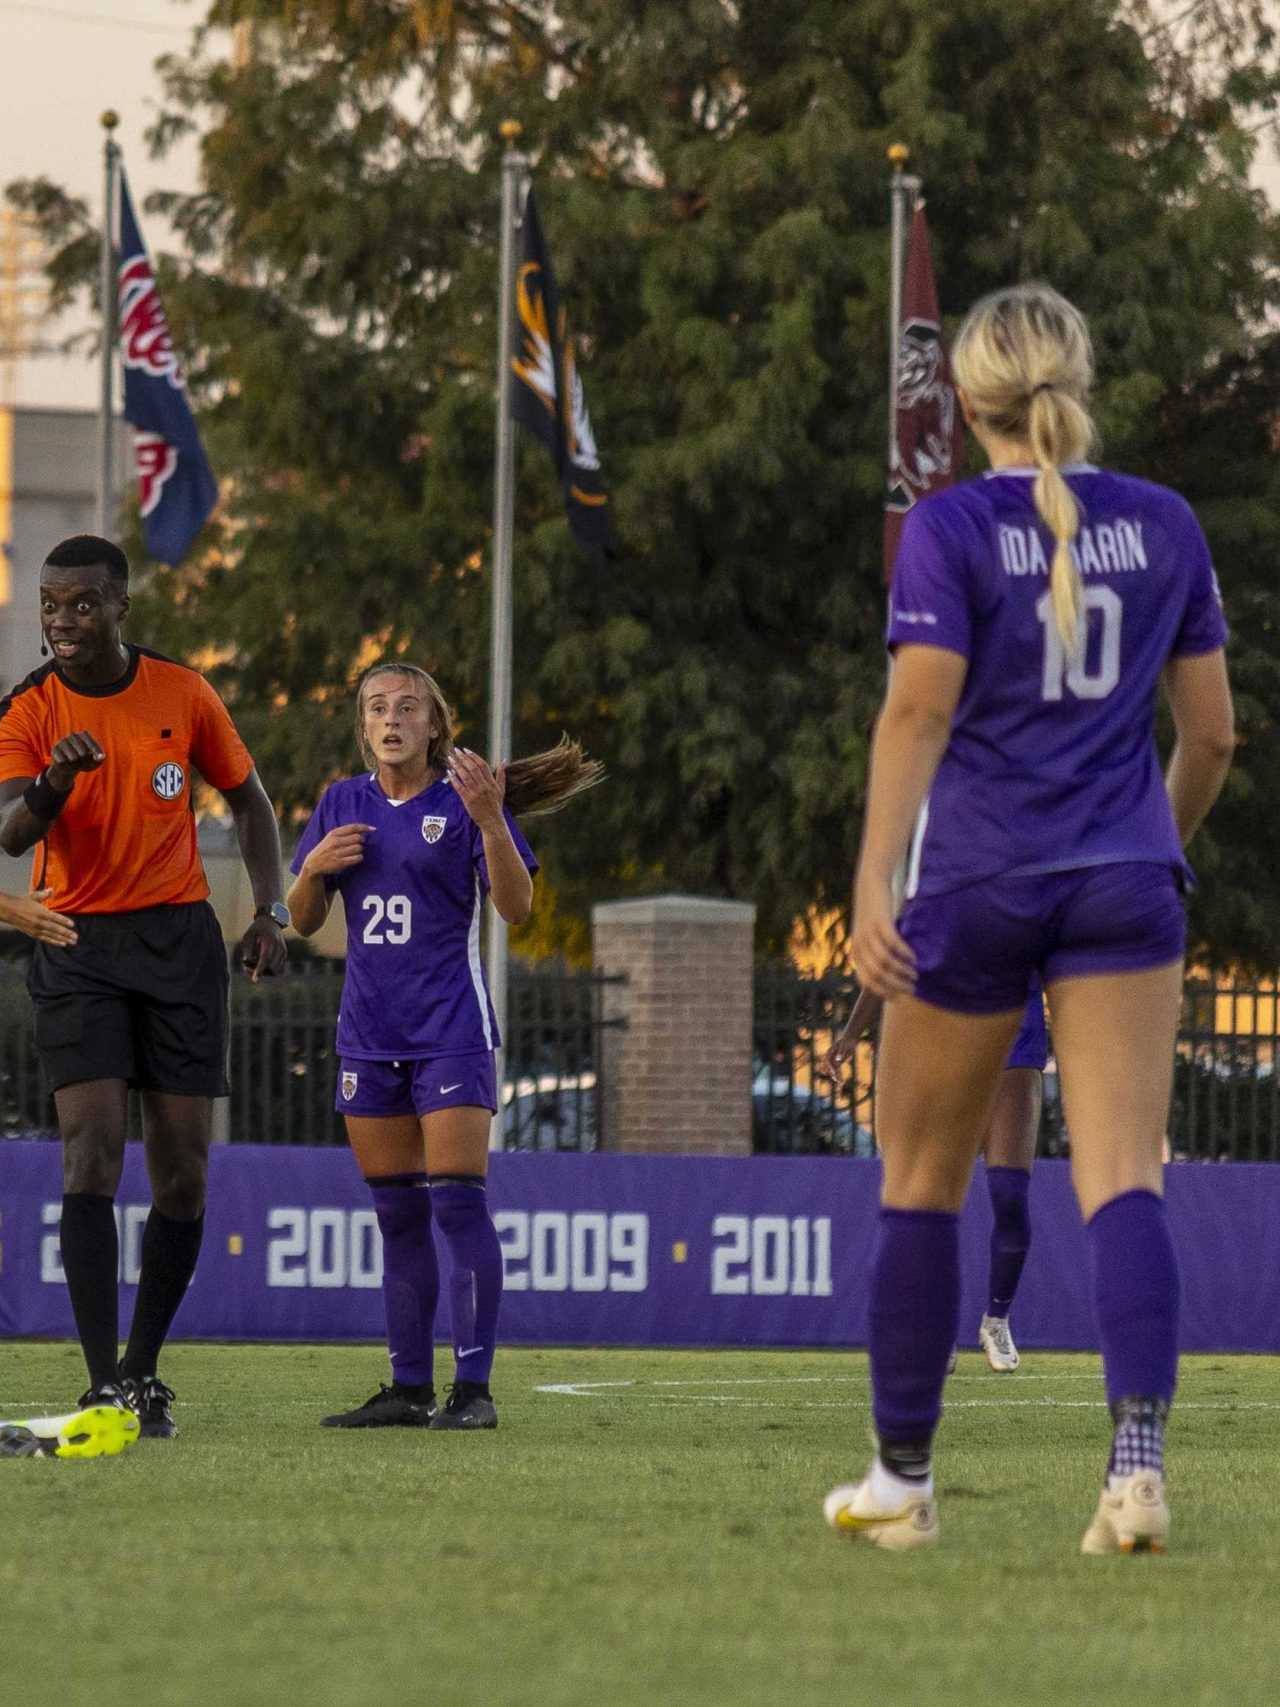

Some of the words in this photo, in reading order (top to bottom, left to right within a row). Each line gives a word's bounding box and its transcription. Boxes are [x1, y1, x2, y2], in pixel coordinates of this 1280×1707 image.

[1036, 583, 1123, 701] 10
[156, 765, 182, 797] SEC
[362, 894, 412, 944] 29
[494, 1213, 648, 1292] 2009
[712, 1216, 832, 1296] 2011
